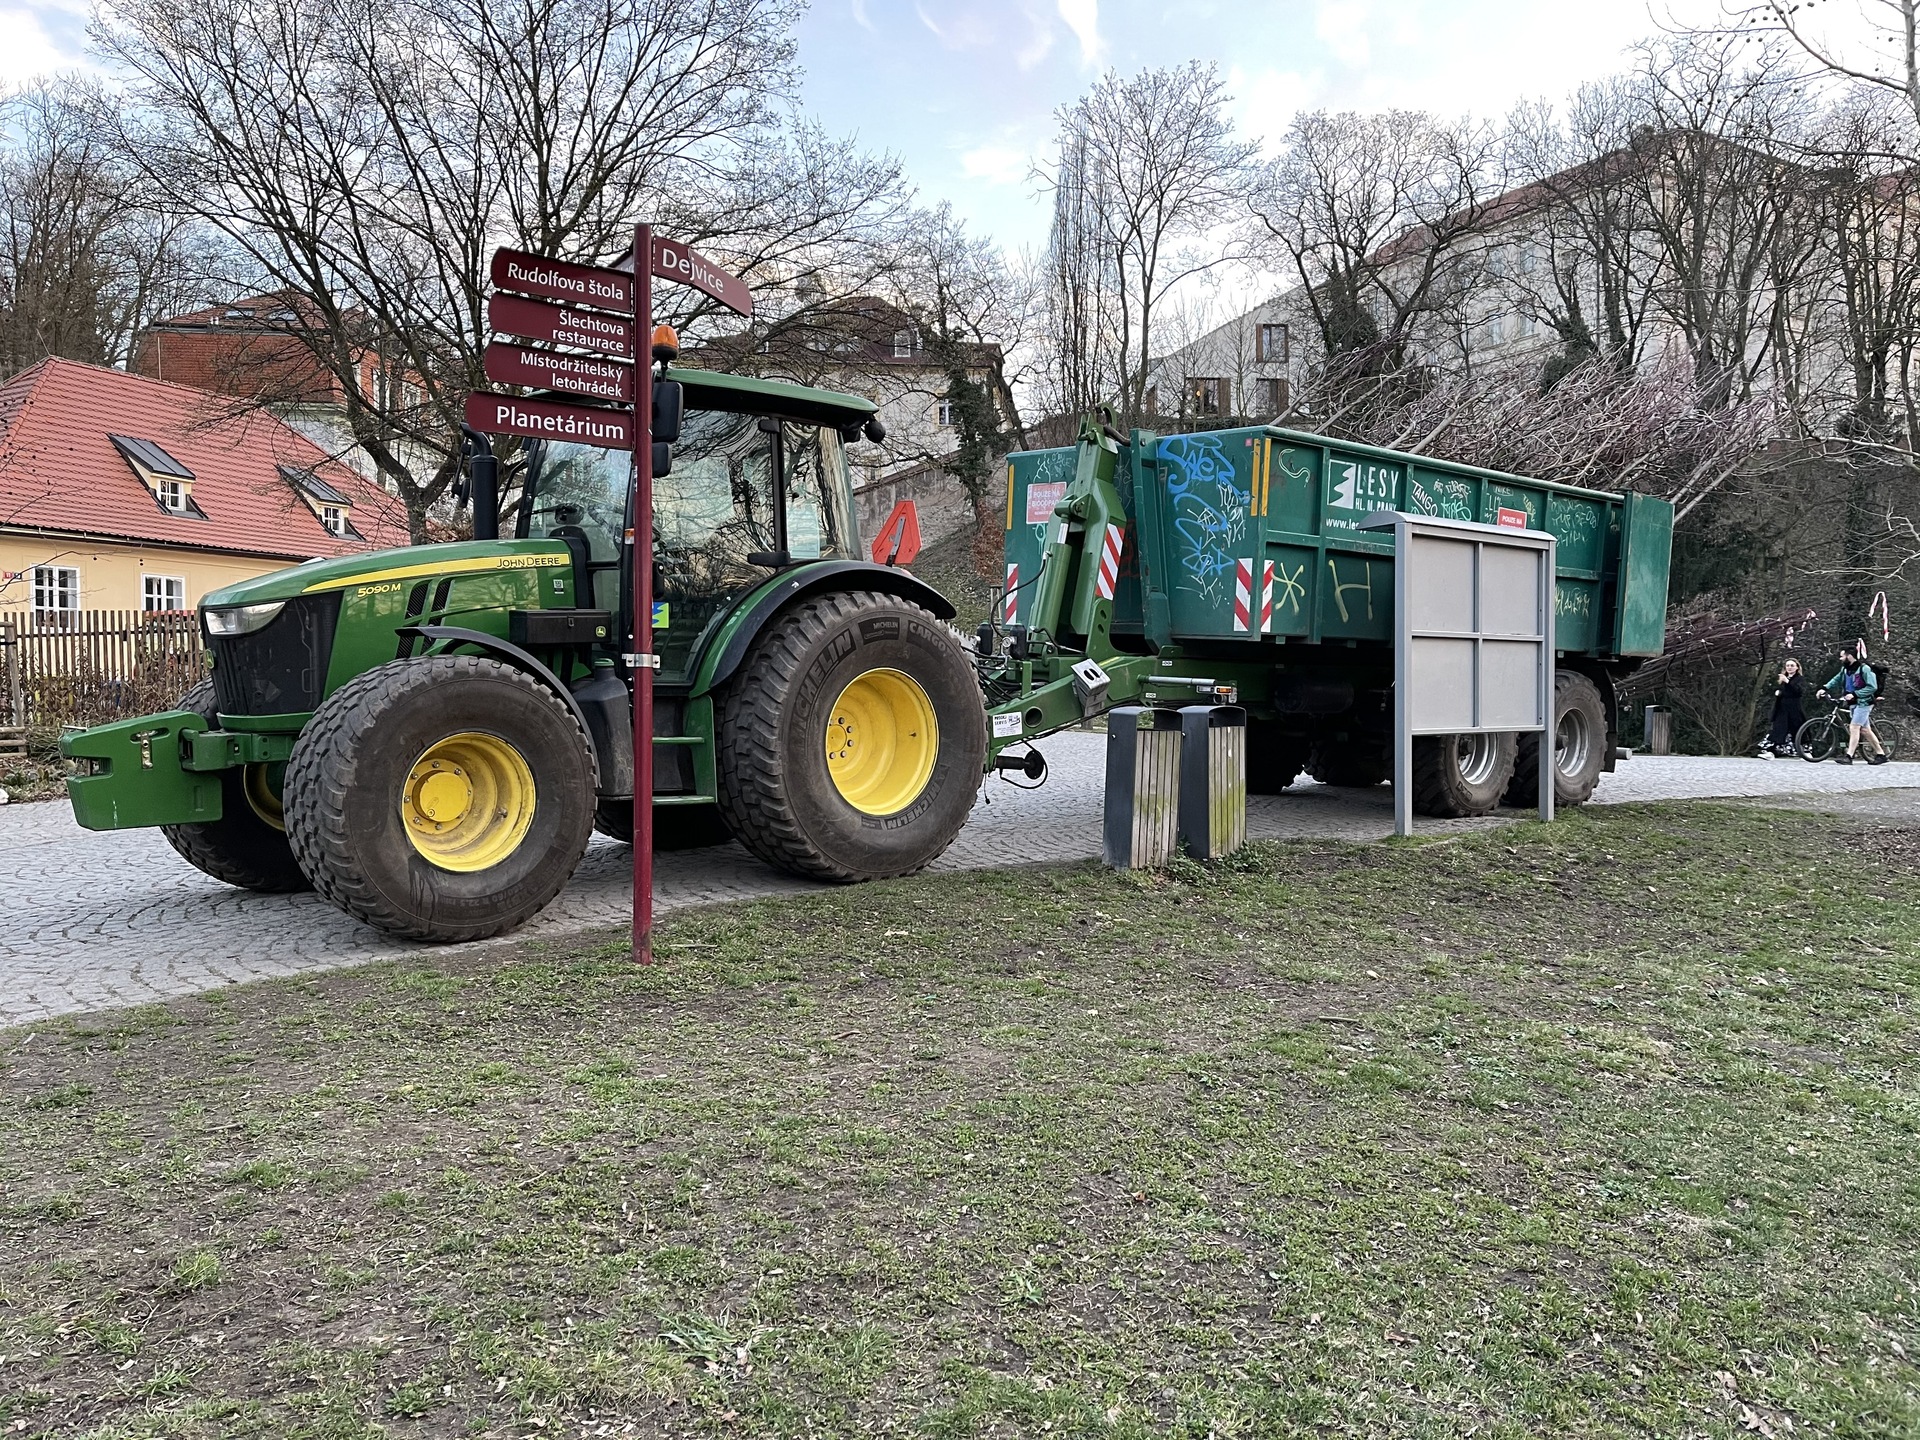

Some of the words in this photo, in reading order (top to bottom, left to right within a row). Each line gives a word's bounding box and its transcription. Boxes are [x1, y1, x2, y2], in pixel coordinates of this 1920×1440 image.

[507, 262, 586, 293] Rudolfova
[588, 279, 624, 301] štola
[662, 248, 724, 294] Dejvice
[558, 309, 624, 337] Šlechtova
[552, 330, 624, 353] restaurace
[520, 351, 624, 383] Místodržitelský
[552, 373, 623, 398] letohrádek
[496, 405, 624, 440] Planetárium
[1356, 464, 1399, 499] LESY
[1411, 480, 1438, 518] TANGO
[497, 558, 527, 568] JOHN
[527, 557, 560, 566] DEERE
[357, 584, 390, 598] 5090
[873, 621, 899, 630] MICHELIN
[886, 781, 941, 830] MICHELIN
